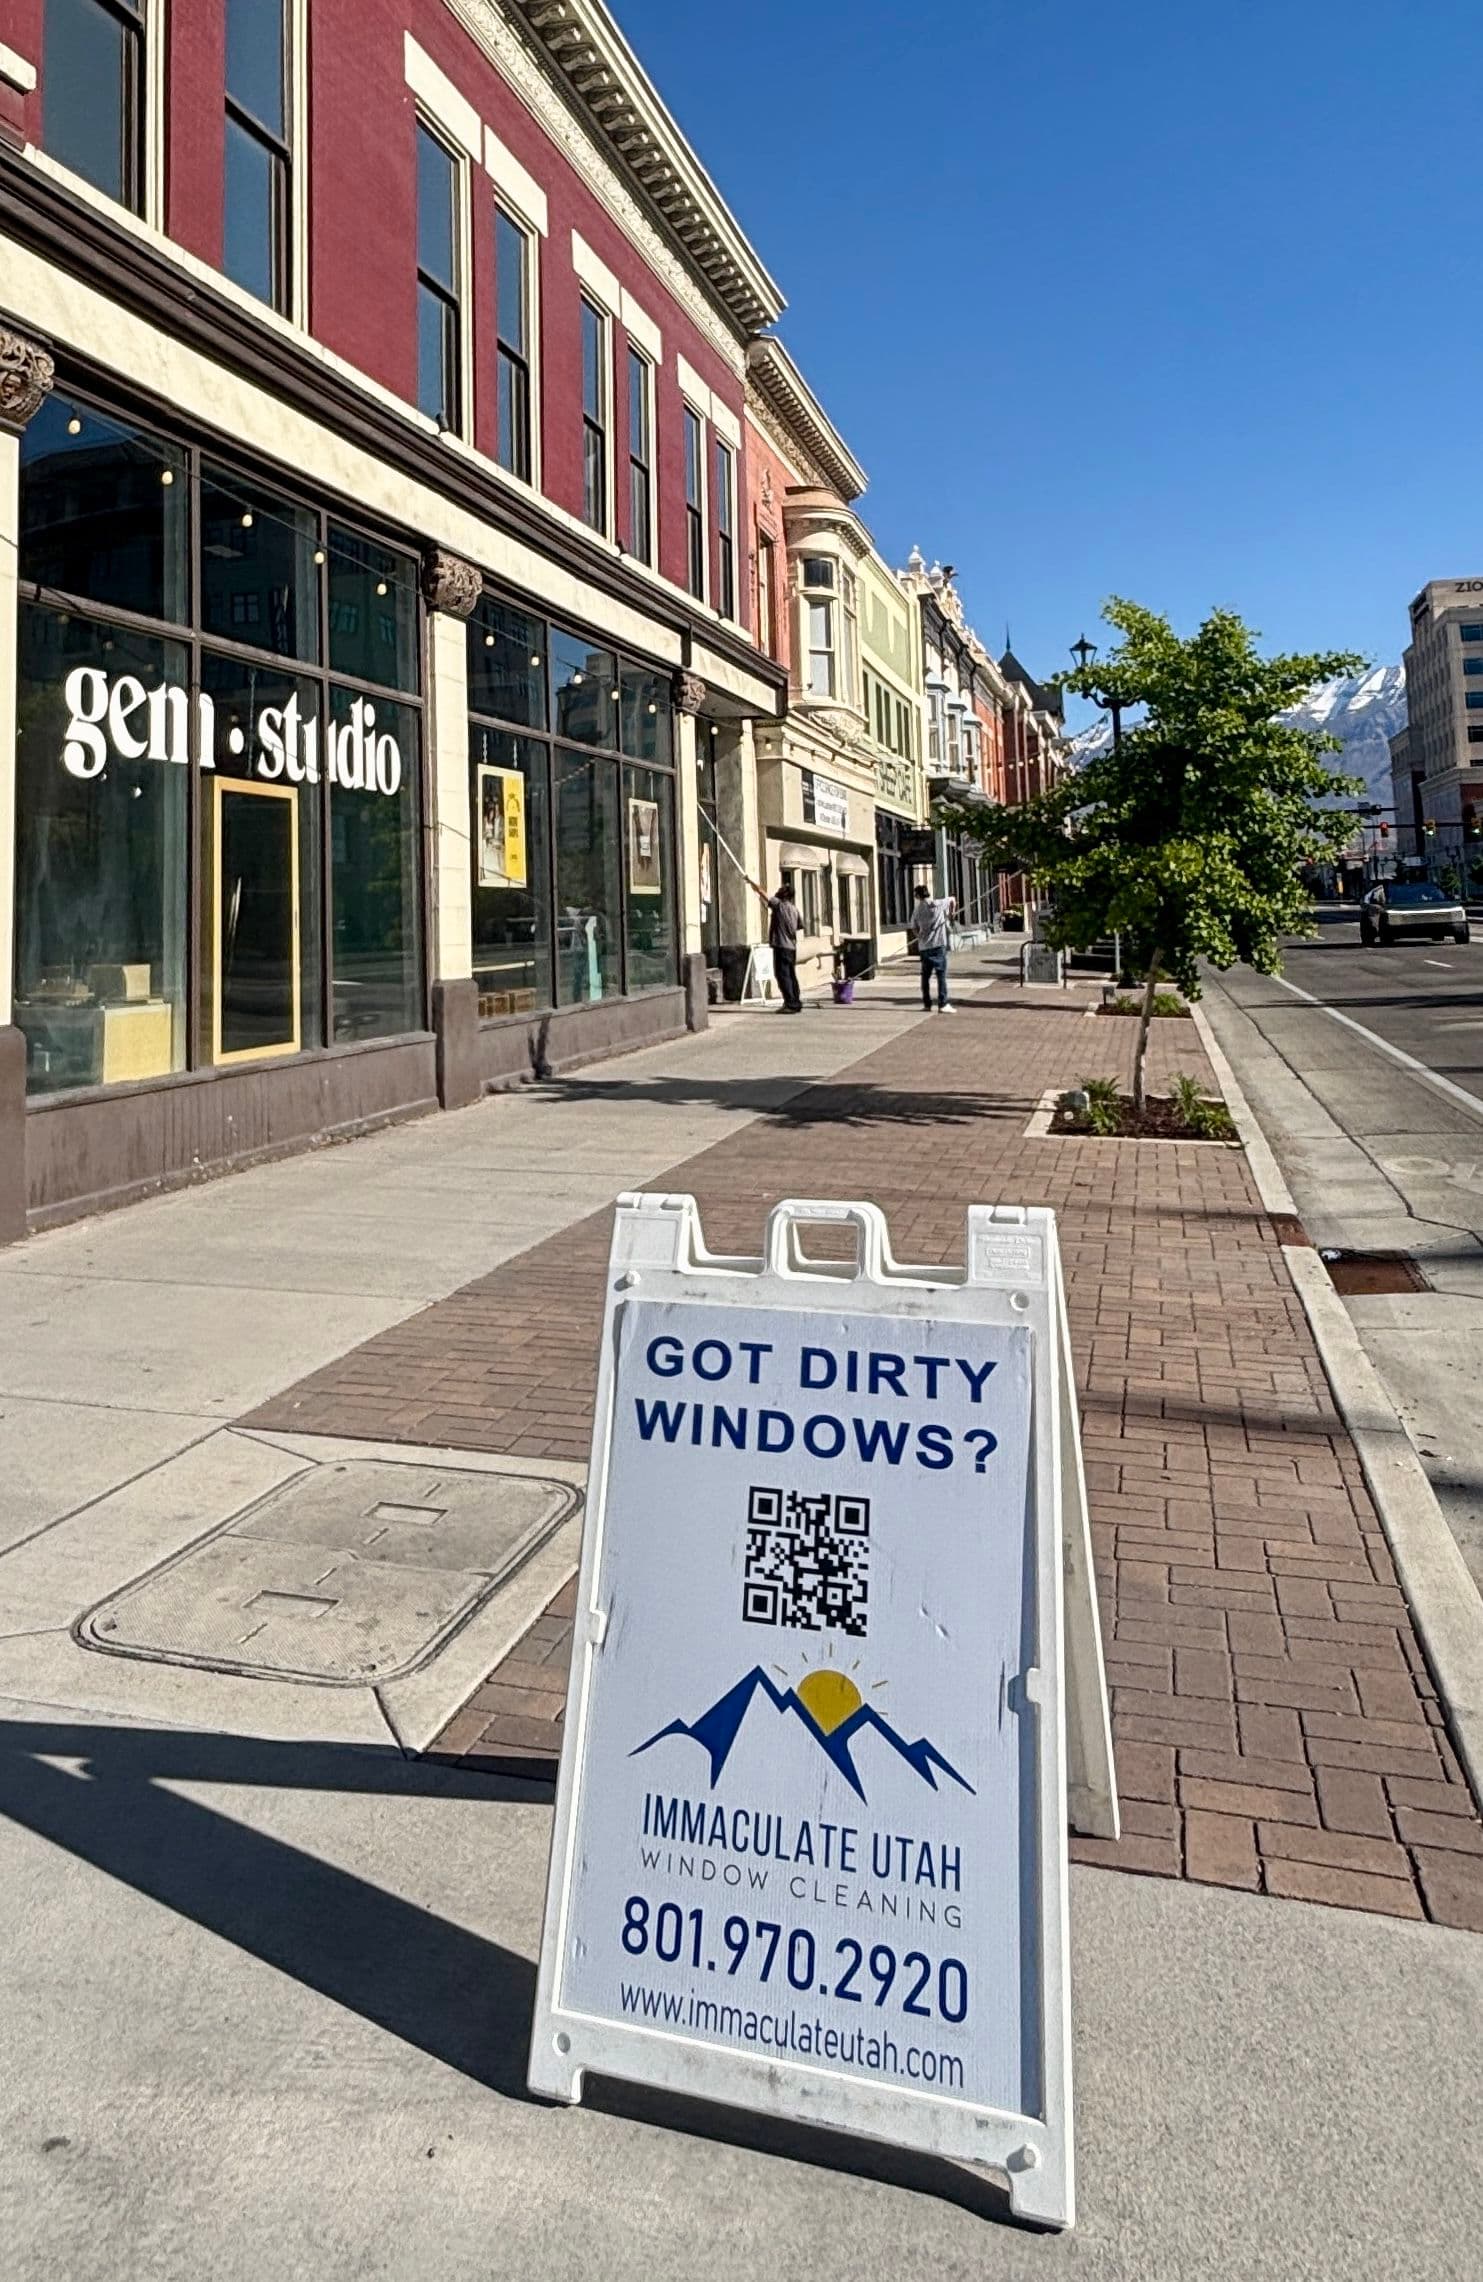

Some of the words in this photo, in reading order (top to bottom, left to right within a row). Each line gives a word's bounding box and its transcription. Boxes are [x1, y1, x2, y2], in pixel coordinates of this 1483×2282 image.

[64, 668, 215, 778] gem
[258, 691, 401, 795] studio
[647, 1336, 773, 1384] GOT
[800, 1347, 998, 1403] DIRTY
[635, 1398, 998, 1474] WINDOWS?
[641, 1848, 769, 1890] WINDOW
[790, 1876, 962, 1928] CLEANING
[643, 1793, 857, 1873] IMMACULATE
[873, 1833, 961, 1892] UTAH
[622, 1896, 968, 2024] 801.970.2920
[621, 1982, 964, 2089] www.immaculateutah.com
